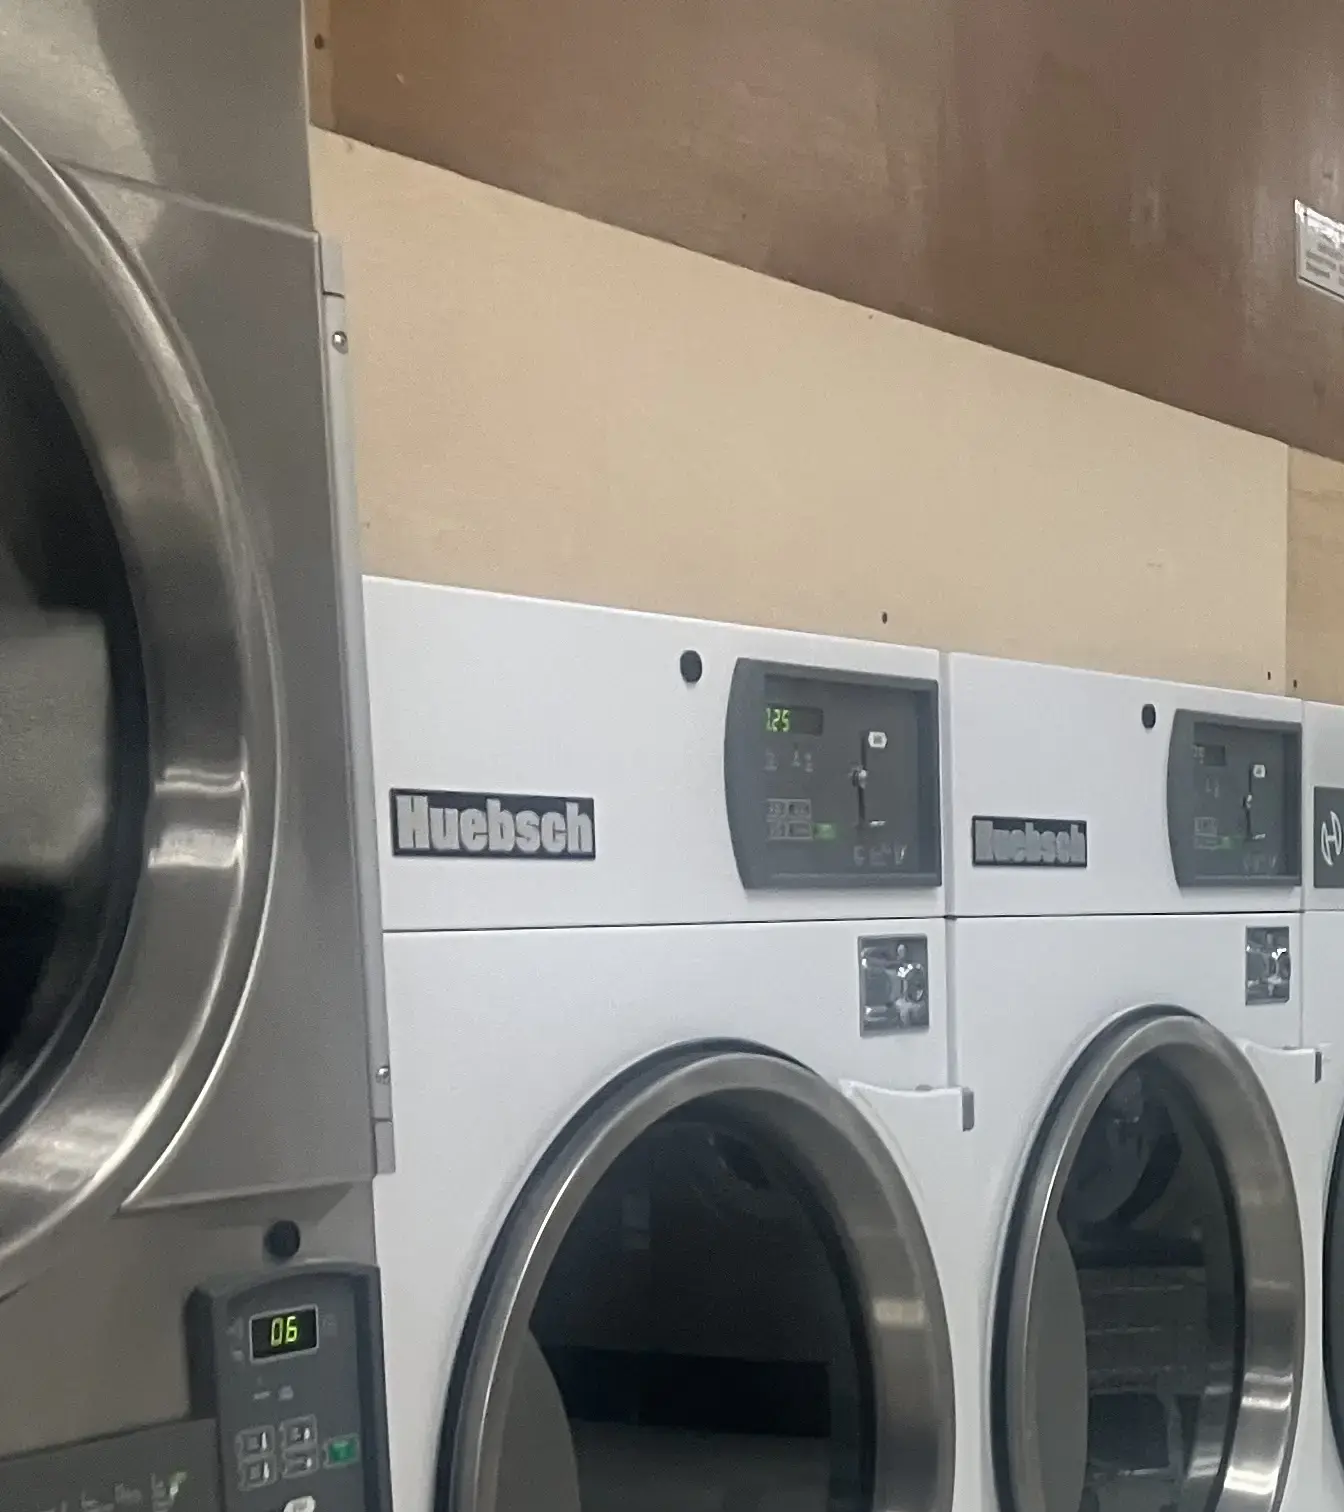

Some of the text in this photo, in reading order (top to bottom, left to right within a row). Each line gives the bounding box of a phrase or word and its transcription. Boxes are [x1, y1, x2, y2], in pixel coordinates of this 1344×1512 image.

[396, 795, 593, 853] Huebsch
[976, 820, 1086, 863] Huebsch
[270, 1315, 298, 1347] 06
